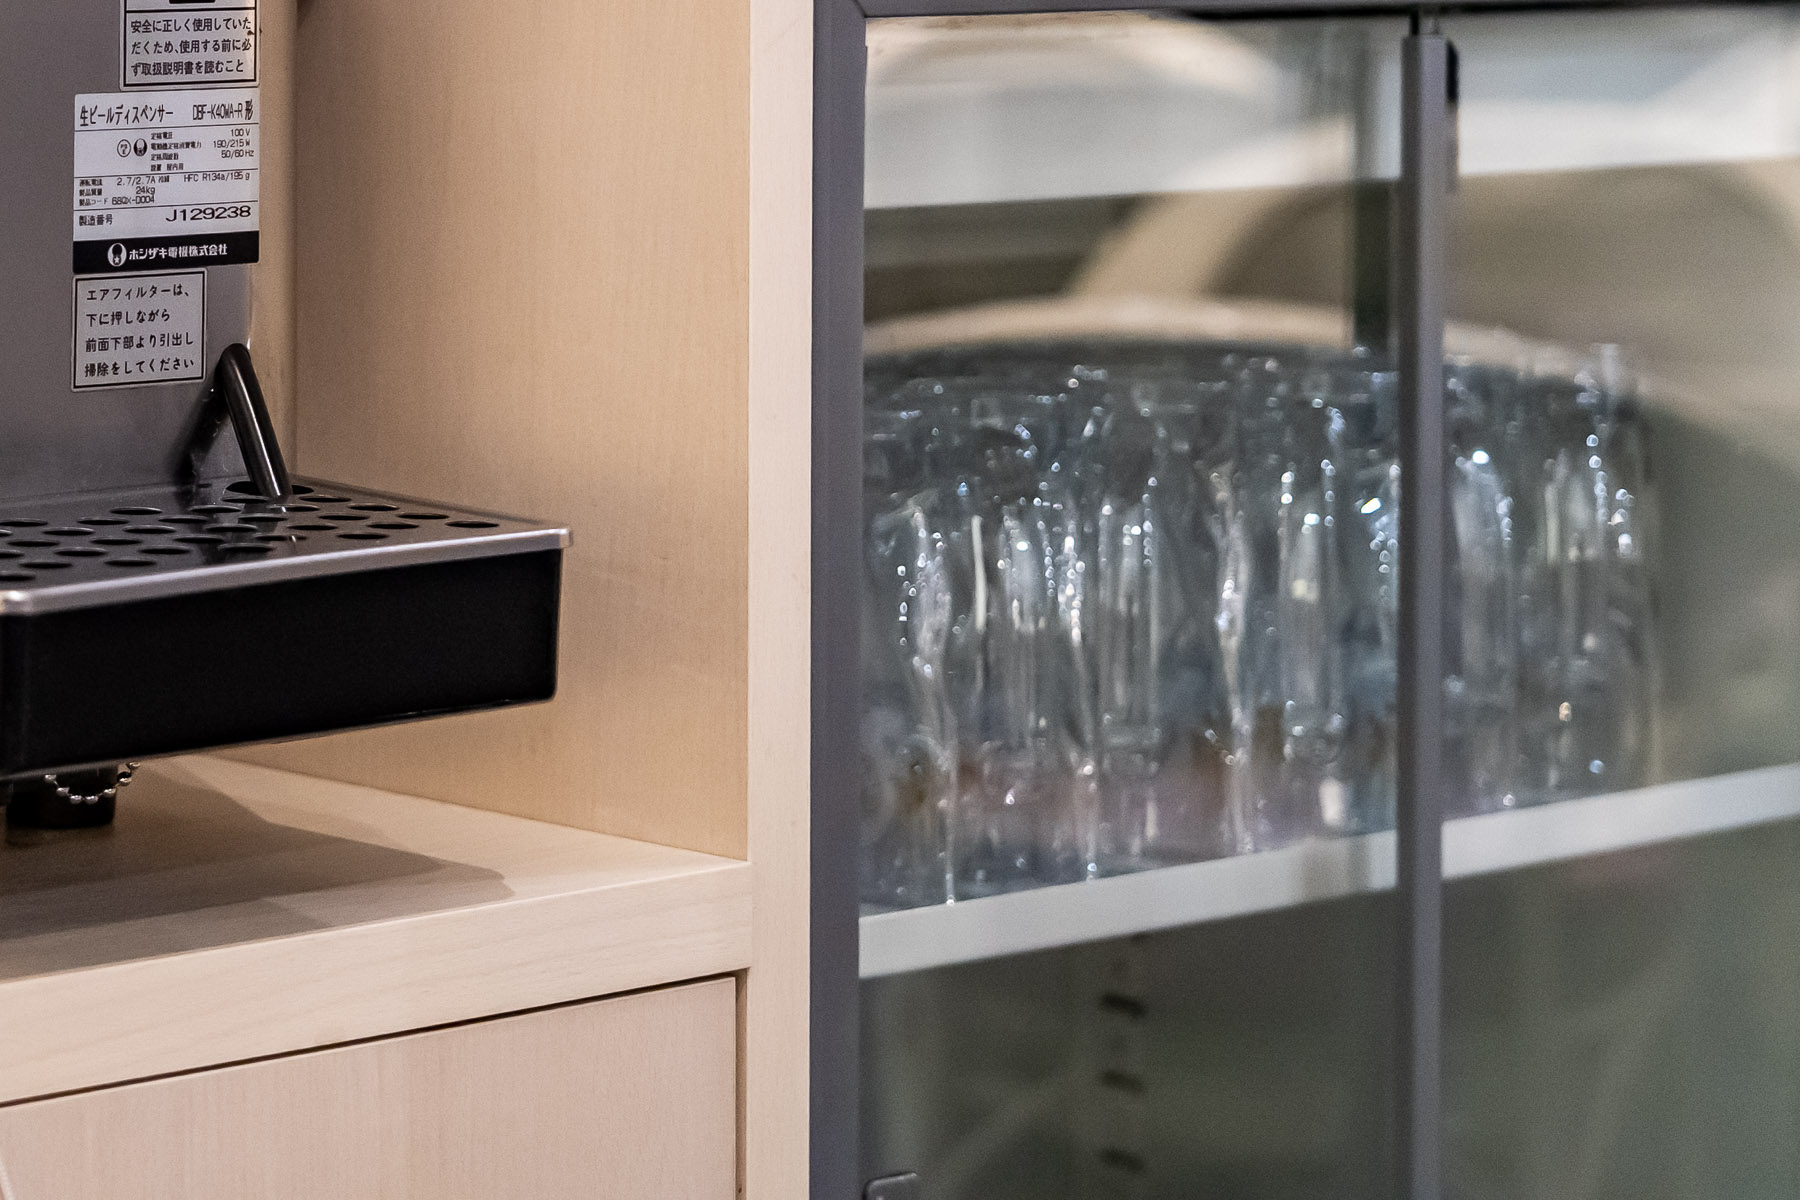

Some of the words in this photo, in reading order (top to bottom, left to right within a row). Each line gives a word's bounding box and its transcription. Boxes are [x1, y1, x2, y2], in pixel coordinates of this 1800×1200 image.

[131, 17, 251, 34] 安全に正しく使用していた
[131, 38, 252, 55] だくため、使用する前に必
[131, 59, 244, 77] ず取扱説明書を読むこと
[80, 103, 174, 127] 生ビールディスペンサー
[183, 174, 199, 183] HFC
[135, 186, 156, 196] 24kg
[78, 214, 114, 227] 製造番号
[165, 205, 251, 222] J129238
[128, 243, 228, 261] ホシザキ電機株式会社
[86, 283, 190, 301] エアフィルターは、
[86, 308, 171, 327] 下に押しながら
[85, 332, 194, 353] 前面下部より引出し
[84, 357, 194, 378] 掃除をしてください
